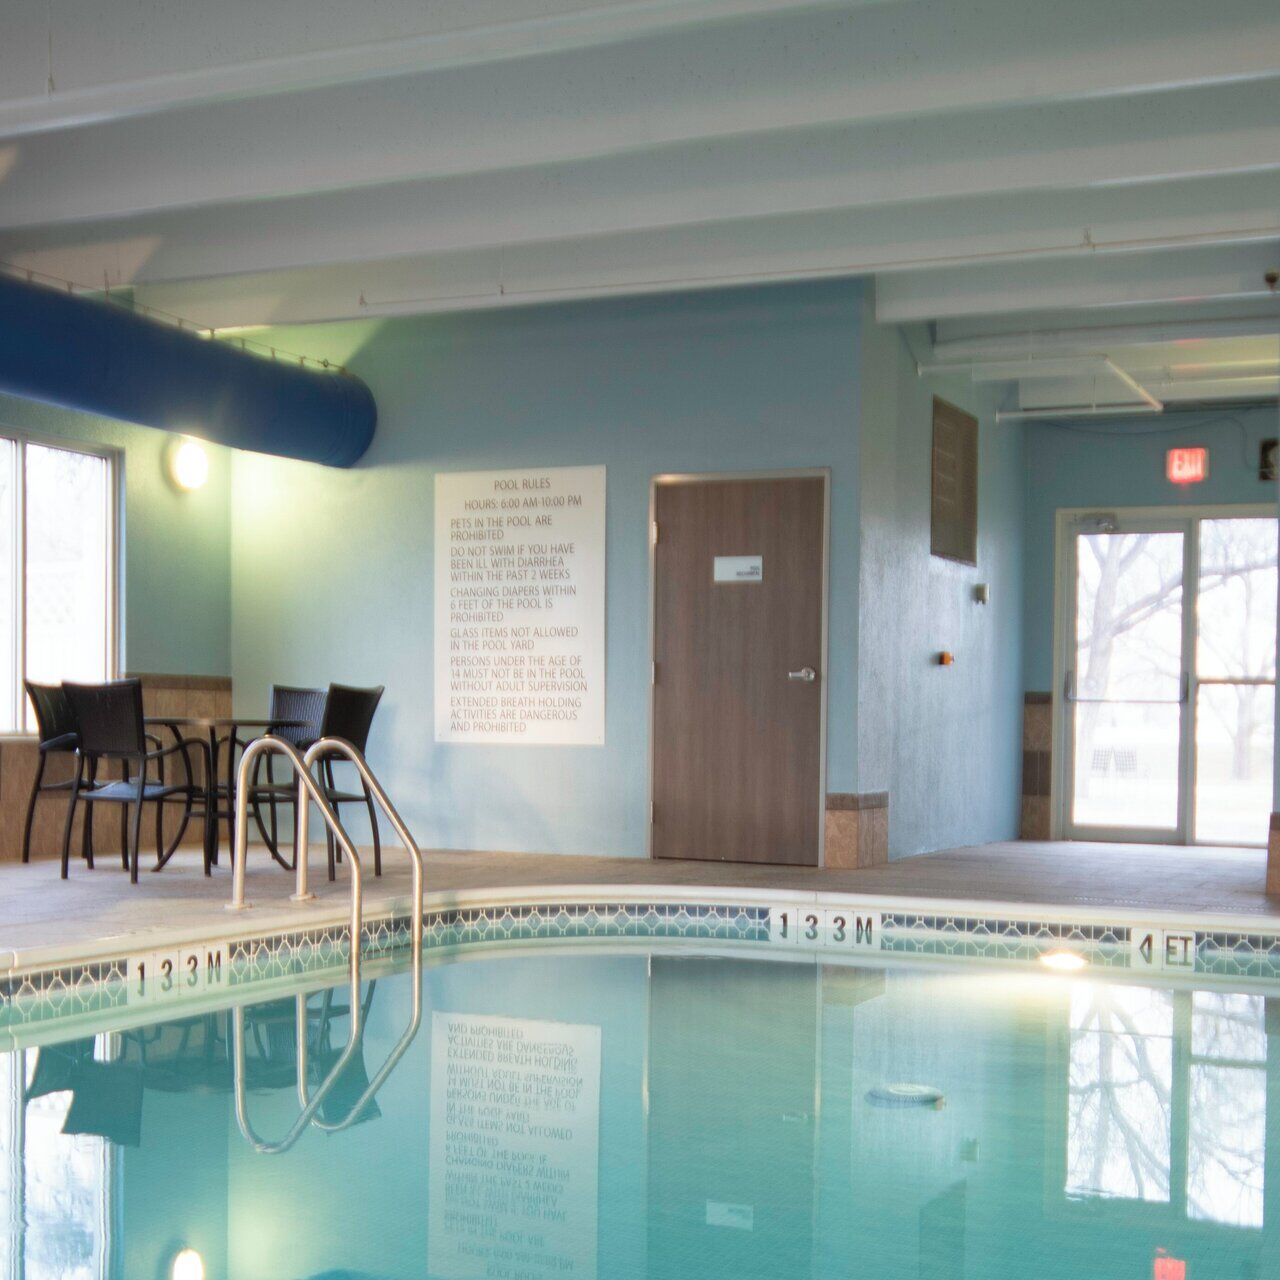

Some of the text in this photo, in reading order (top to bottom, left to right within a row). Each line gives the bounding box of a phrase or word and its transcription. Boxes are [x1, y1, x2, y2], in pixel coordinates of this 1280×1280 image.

[1170, 448, 1204, 482] EXIT
[494, 478, 551, 491] POOL RULES
[568, 495, 582, 506] PM
[451, 515, 553, 529] PETS IN THE POOL ARE
[451, 529, 504, 541] PROHIBITED
[451, 543, 575, 557] DO NOT SWIM IF YOU HAVE
[451, 557, 564, 569] BEEN ILL WITH DIARRHEA
[451, 569, 570, 582] WITHIN THE PAST 2 WEEKS
[450, 585, 576, 597] CHANGING DIAPERS WITHIN
[459, 599, 478, 609] FEET
[482, 599, 493, 609] OF
[498, 598, 514, 609] THE
[517, 598, 542, 609] POOL
[545, 598, 553, 608] IS
[451, 612, 503, 622] PROHIBITED
[450, 627, 578, 638] GLASS ITEMS NOT ALLOWED
[451, 640, 535, 650] IN THE POOL YARD
[450, 655, 582, 666] PERSONS UNDER THE AGE OF
[452, 668, 585, 679] 14 MUST NOT BE IN THE POOL
[451, 681, 588, 692] WITHOUT ADULT SUPERVISION
[451, 697, 582, 708] EXTENDED BREATH HOLDING
[450, 709, 578, 720] ACTIVITIES ARE DANGEROUS
[450, 722, 527, 732] AND PROHIBITED
